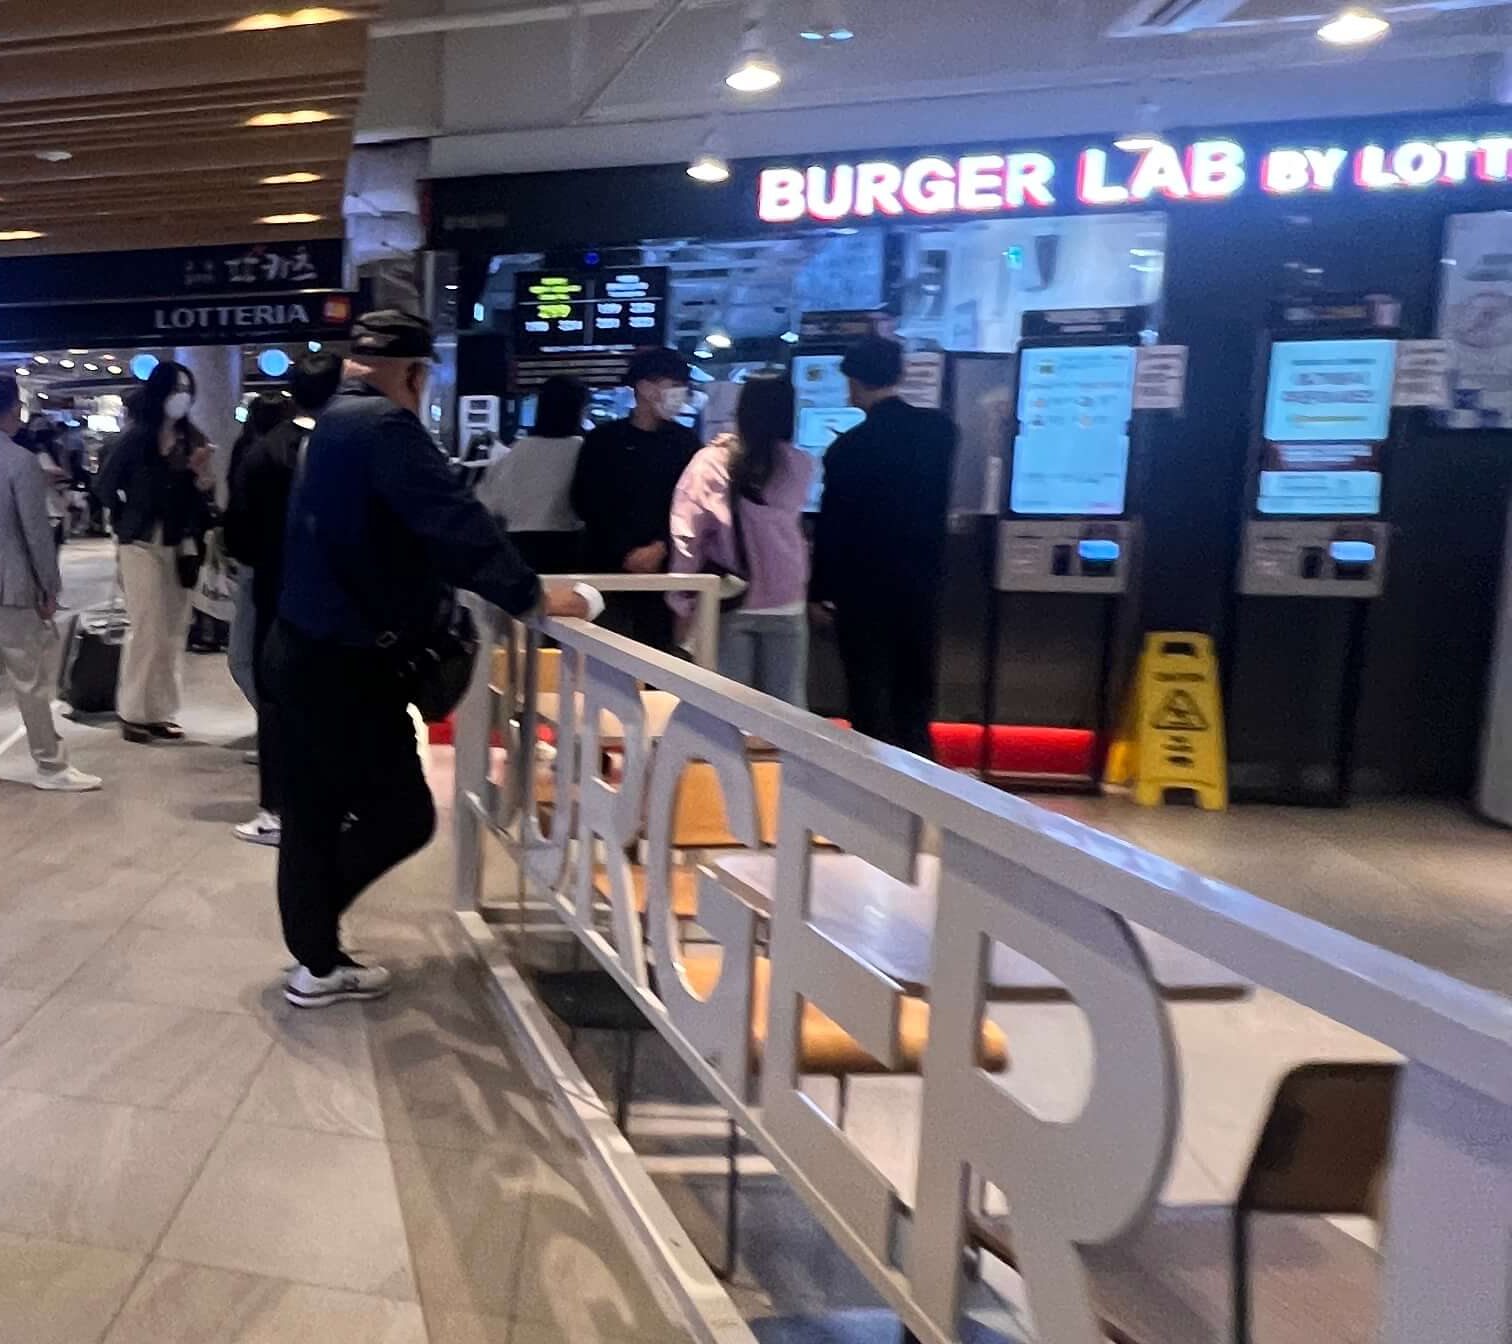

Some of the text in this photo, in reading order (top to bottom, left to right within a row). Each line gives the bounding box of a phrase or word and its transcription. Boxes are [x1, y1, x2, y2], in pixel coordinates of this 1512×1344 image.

[757, 151, 1055, 223] BURGER
[1077, 138, 1245, 205] LAB
[1262, 147, 1348, 194] BY
[154, 304, 310, 329] LOTTERIA
